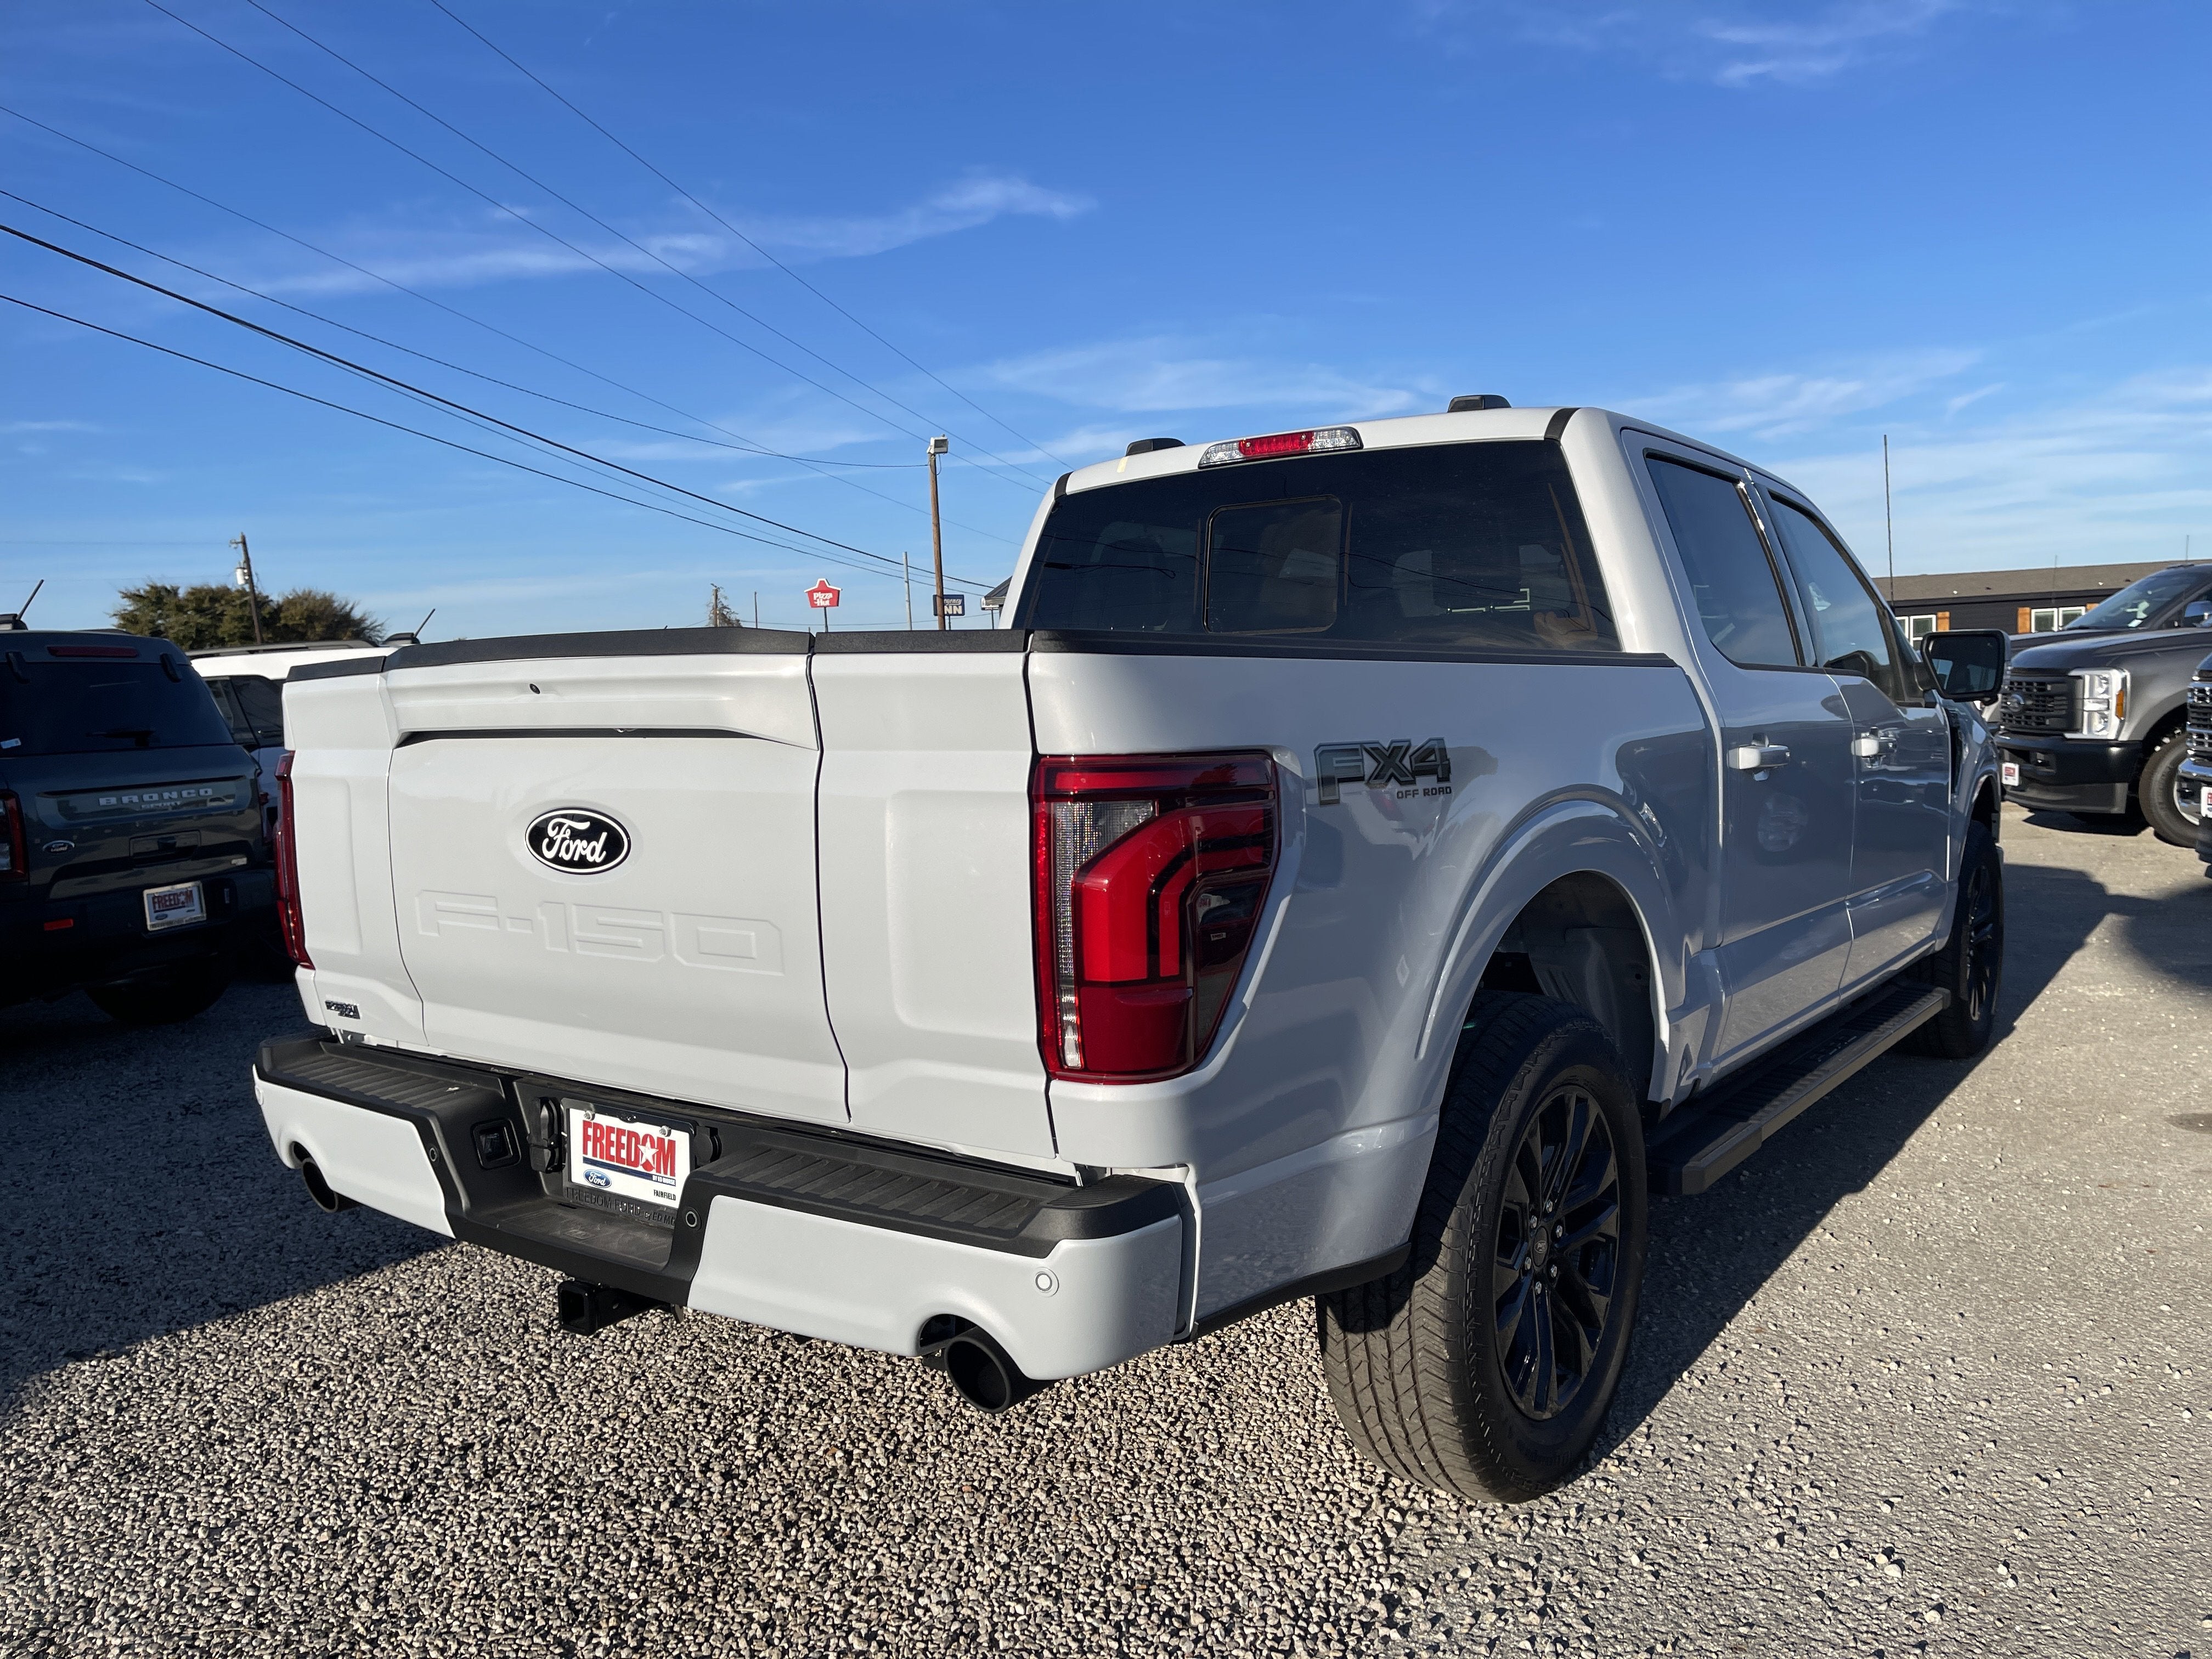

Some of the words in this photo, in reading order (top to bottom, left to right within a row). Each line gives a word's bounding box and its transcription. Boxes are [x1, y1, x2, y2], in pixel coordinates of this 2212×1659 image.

[813, 592, 833, 600] Pizza
[944, 605, 962, 614] NN
[1313, 737, 1451, 807] FX4
[99, 788, 212, 806] BRONCO
[1396, 789, 1419, 799] OFF
[1423, 786, 1452, 797] ROAD
[542, 817, 608, 863] Ford
[152, 890, 194, 911] FREEDOM
[415, 889, 785, 975] F-150
[583, 1120, 676, 1177] FREEDOM
[588, 1171, 606, 1187] Ford
[566, 1187, 612, 1209] FREEDOM
[614, 1198, 641, 1216] FORD
[653, 1189, 676, 1201] FAIRFIELD
